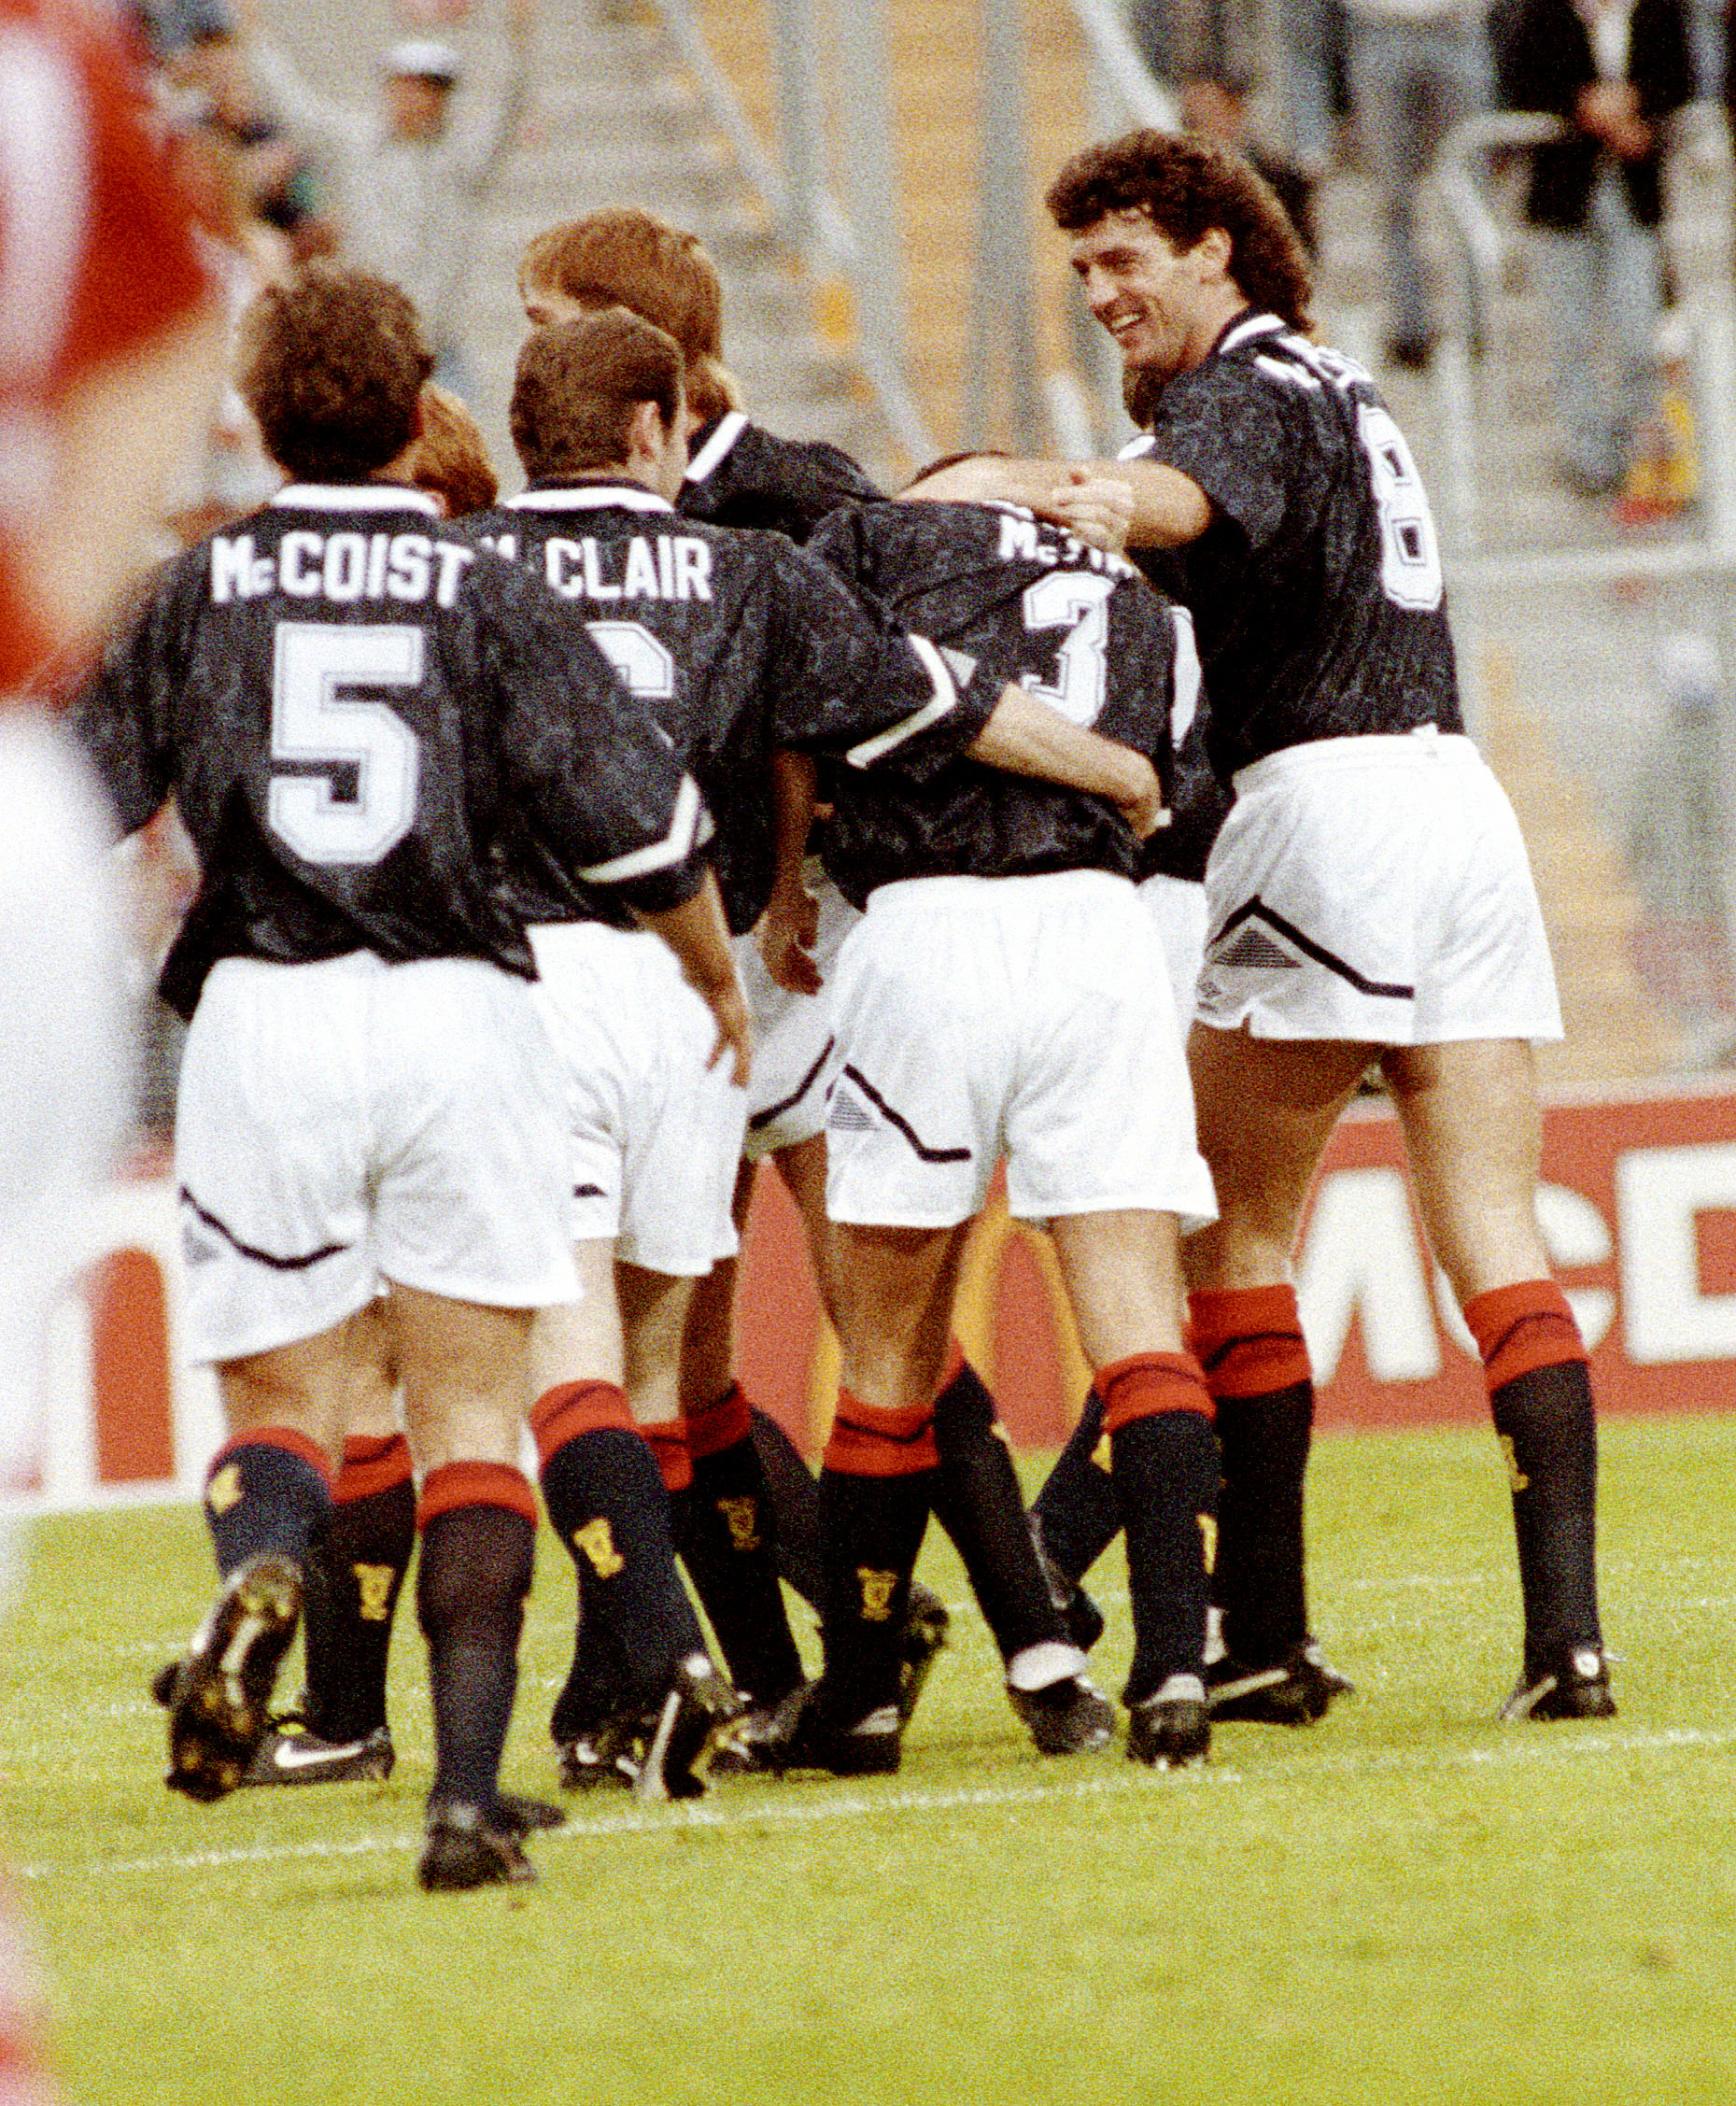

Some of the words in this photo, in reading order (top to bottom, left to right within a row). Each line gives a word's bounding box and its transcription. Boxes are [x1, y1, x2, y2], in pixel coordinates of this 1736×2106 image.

[210, 530, 473, 609] McCOIST
[479, 534, 713, 601] CLAIR
[1357, 402, 1445, 612] 8
[1023, 571, 1116, 730] 3
[267, 621, 427, 864] 5
